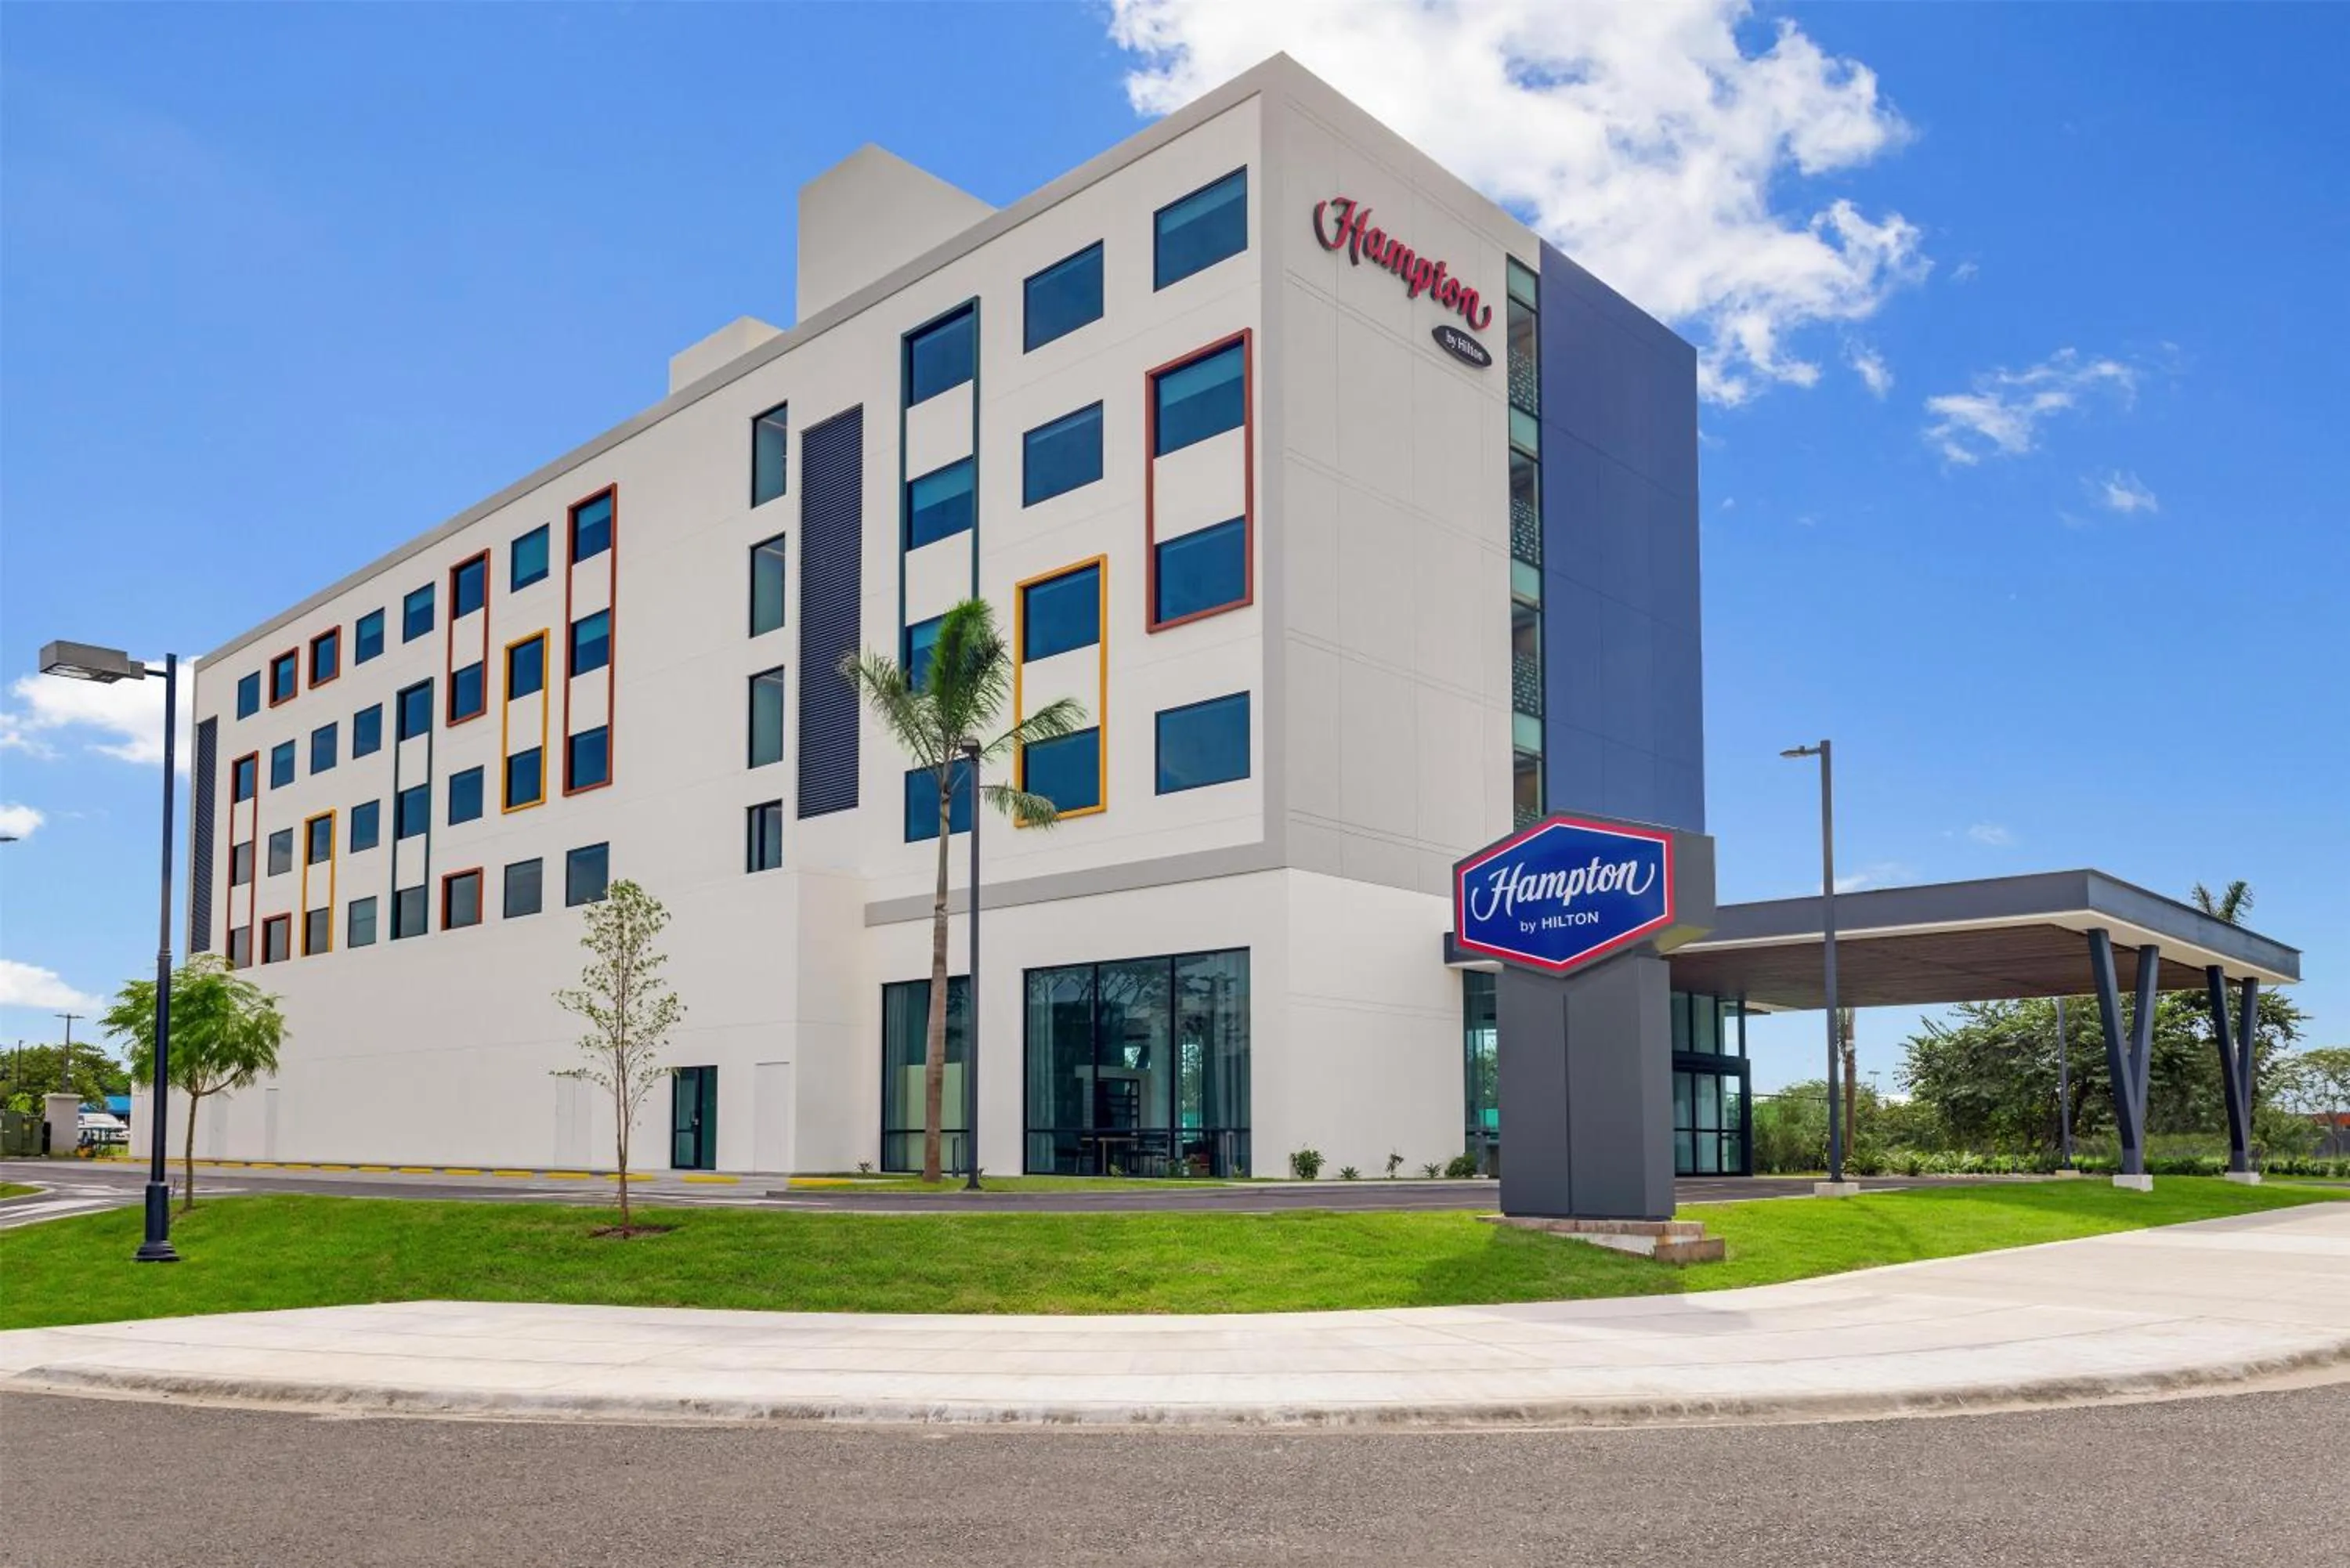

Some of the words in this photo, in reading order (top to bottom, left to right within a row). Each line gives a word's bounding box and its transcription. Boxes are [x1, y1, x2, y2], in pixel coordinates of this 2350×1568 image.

[1313, 197, 1491, 331] Hampton
[1446, 330, 1456, 349] by
[1458, 338, 1484, 362] Hilton
[1471, 856, 1655, 921] Hampton
[1520, 920, 1536, 934] by
[1541, 911, 1599, 930] HILTON
